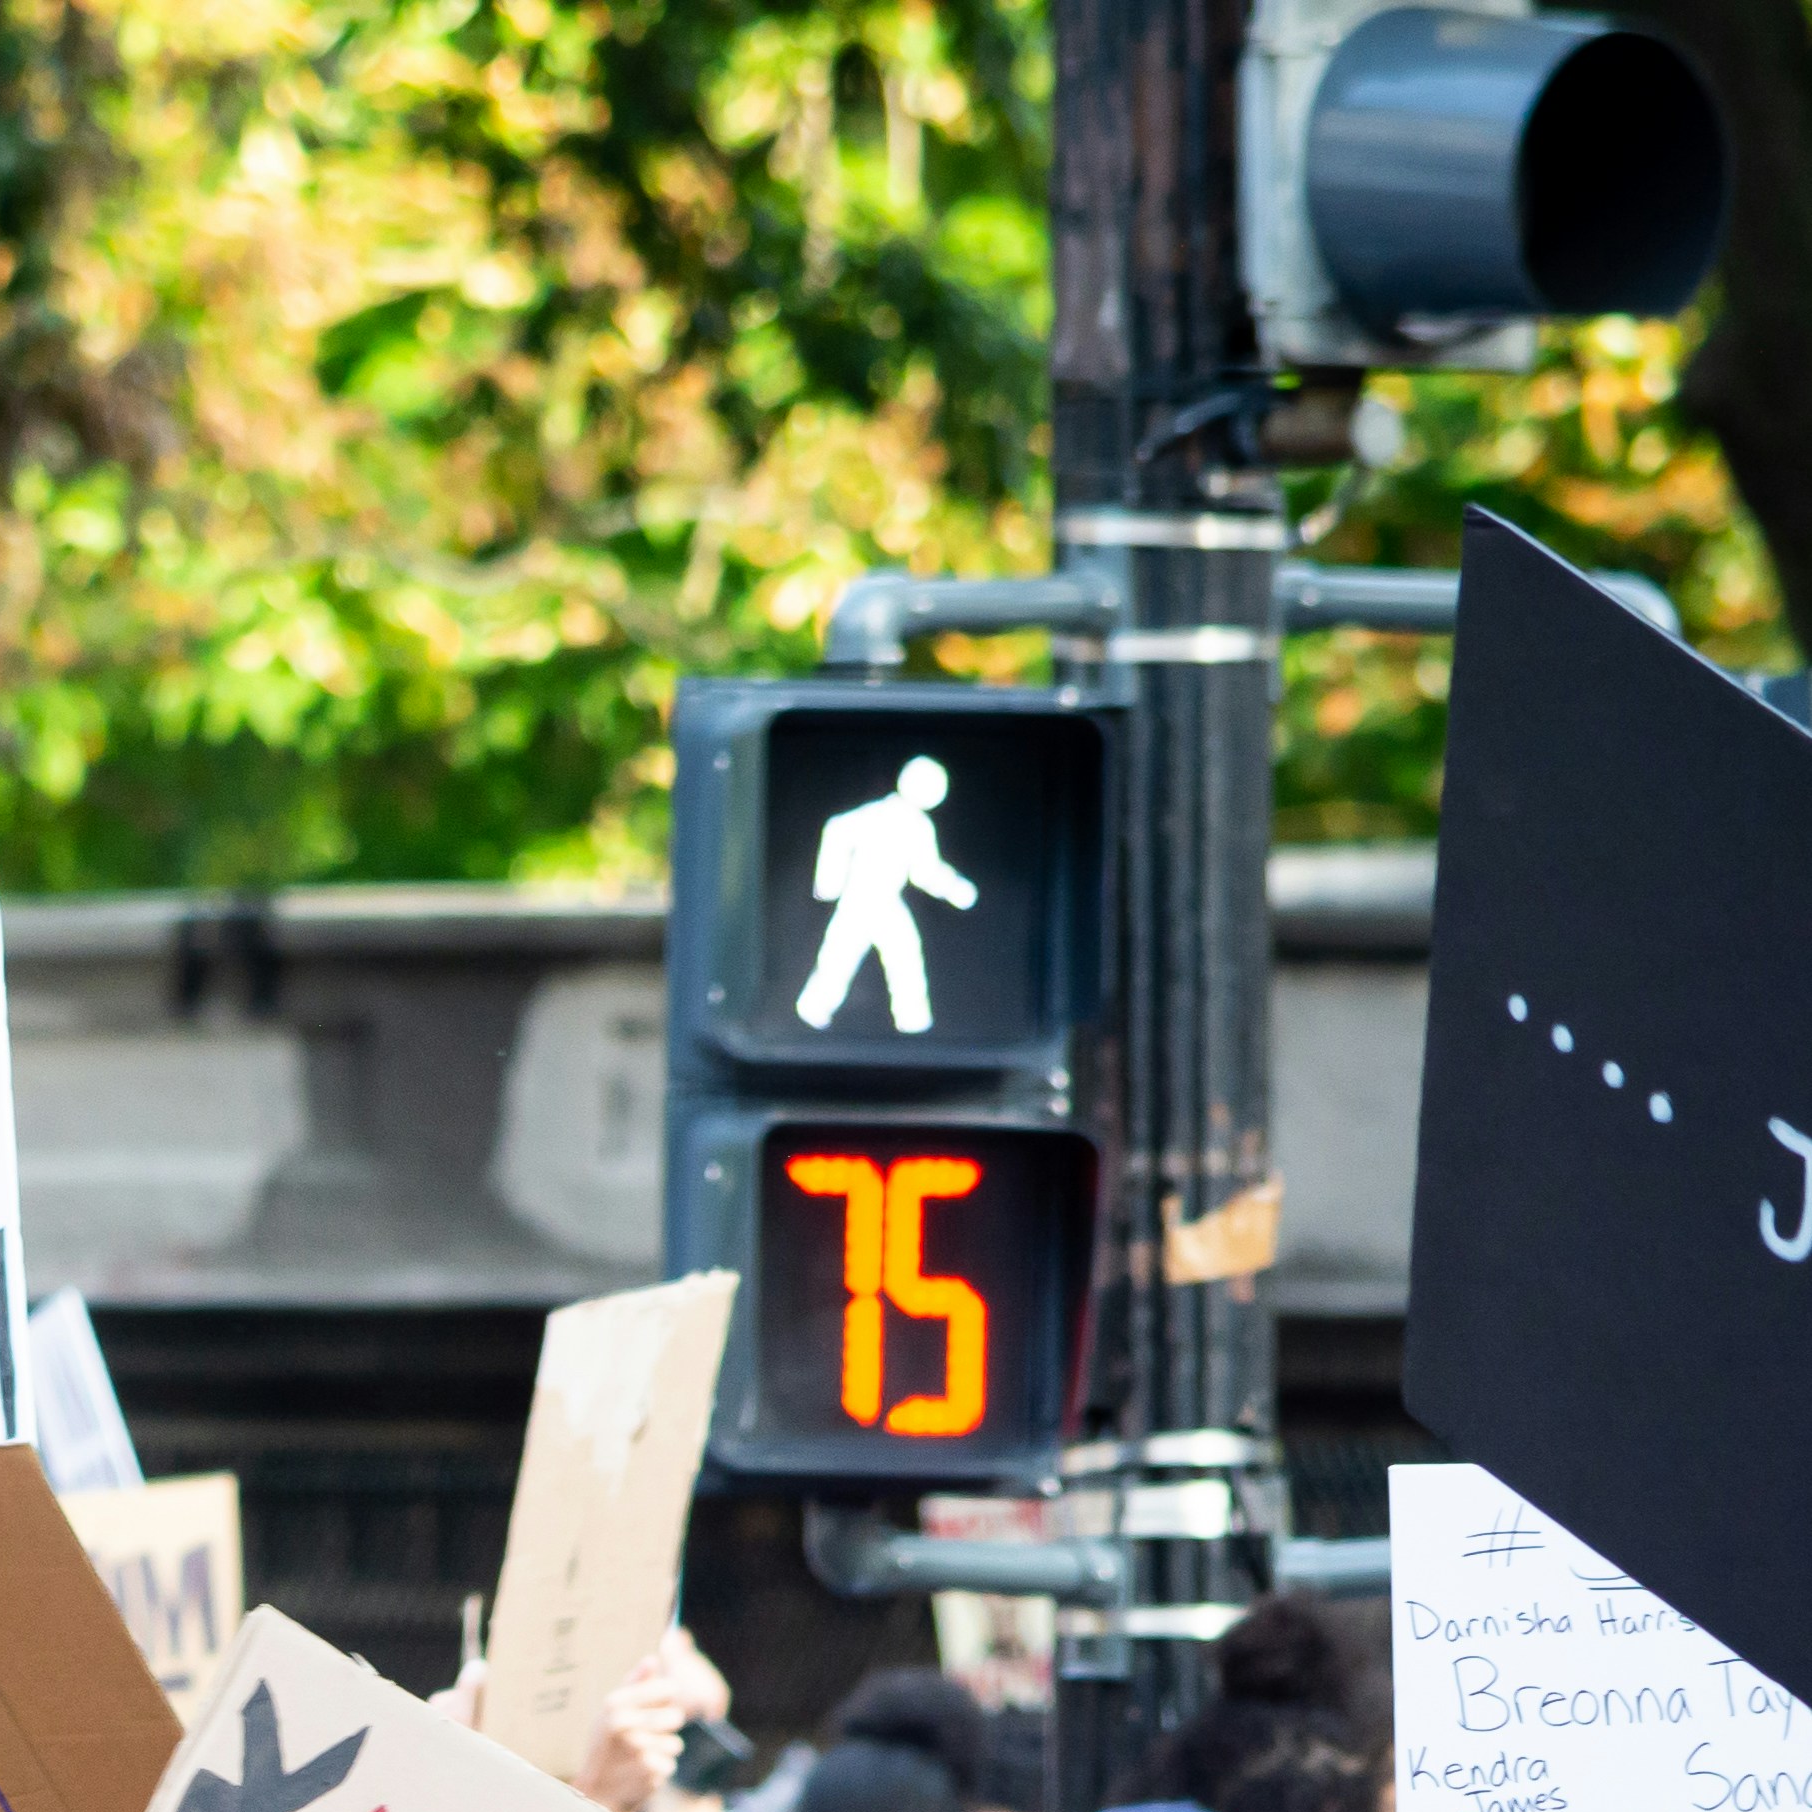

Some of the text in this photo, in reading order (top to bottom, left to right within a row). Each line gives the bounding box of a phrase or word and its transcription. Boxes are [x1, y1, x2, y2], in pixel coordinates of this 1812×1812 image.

[785, 1153, 987, 1438] 75
[1404, 1600, 1574, 1643] Darnisha
[1452, 1655, 1799, 1742] Breonna Tay
[1407, 1746, 1550, 1791] Kendra
